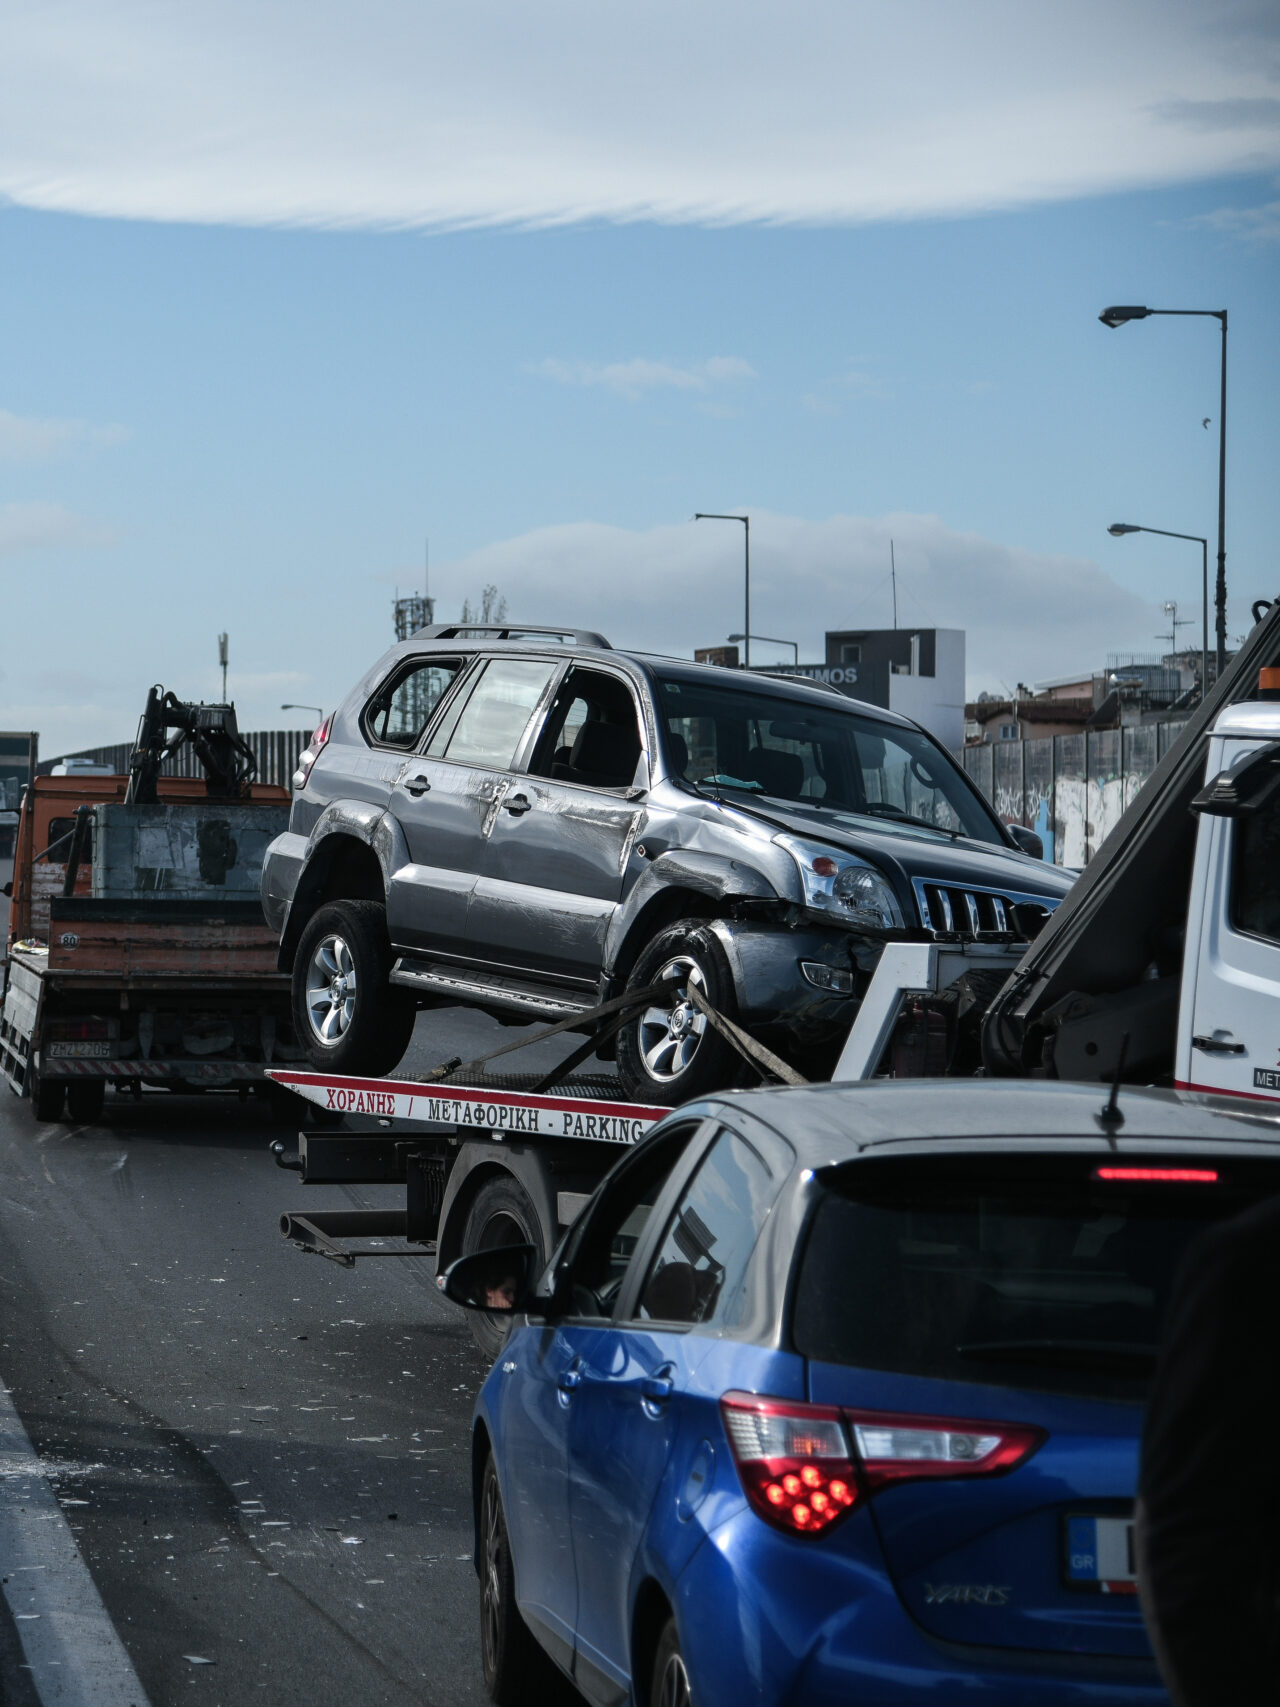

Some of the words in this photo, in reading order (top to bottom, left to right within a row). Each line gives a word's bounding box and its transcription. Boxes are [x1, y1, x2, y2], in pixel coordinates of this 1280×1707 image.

[63, 936, 76, 946] 80
[326, 1088, 396, 1115] ΧΟΡΑΝΗΣ
[428, 1098, 540, 1132] ΜΕΤΑΦΟΡΙΚΗ
[562, 1112, 644, 1144] PARKING
[1072, 1554, 1094, 1569] GR
[924, 1583, 1011, 1606] YARIS
